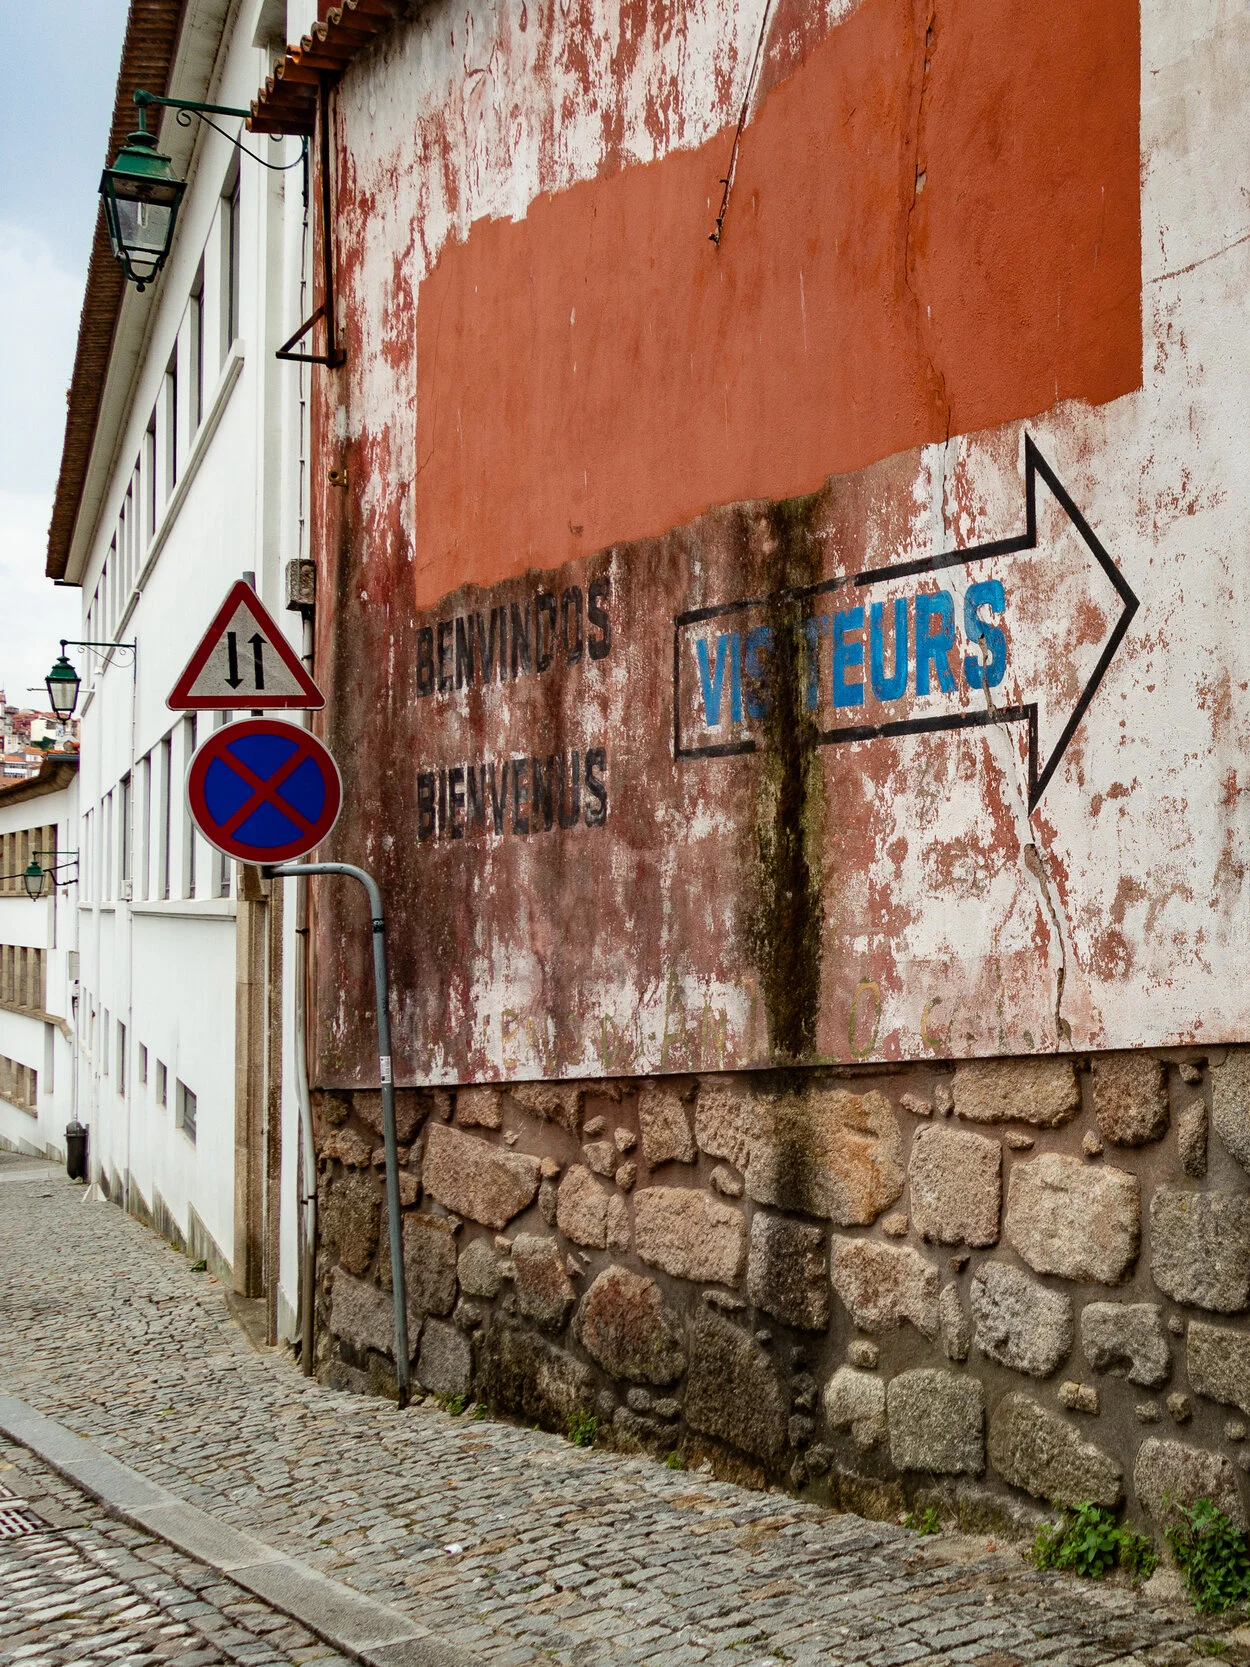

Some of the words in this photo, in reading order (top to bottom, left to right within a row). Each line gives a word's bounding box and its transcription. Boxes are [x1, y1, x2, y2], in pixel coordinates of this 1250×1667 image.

[416, 575, 611, 698] BENVINDOS
[696, 579, 1007, 727] VISTEURS
[417, 747, 607, 842] BIENVENUS
